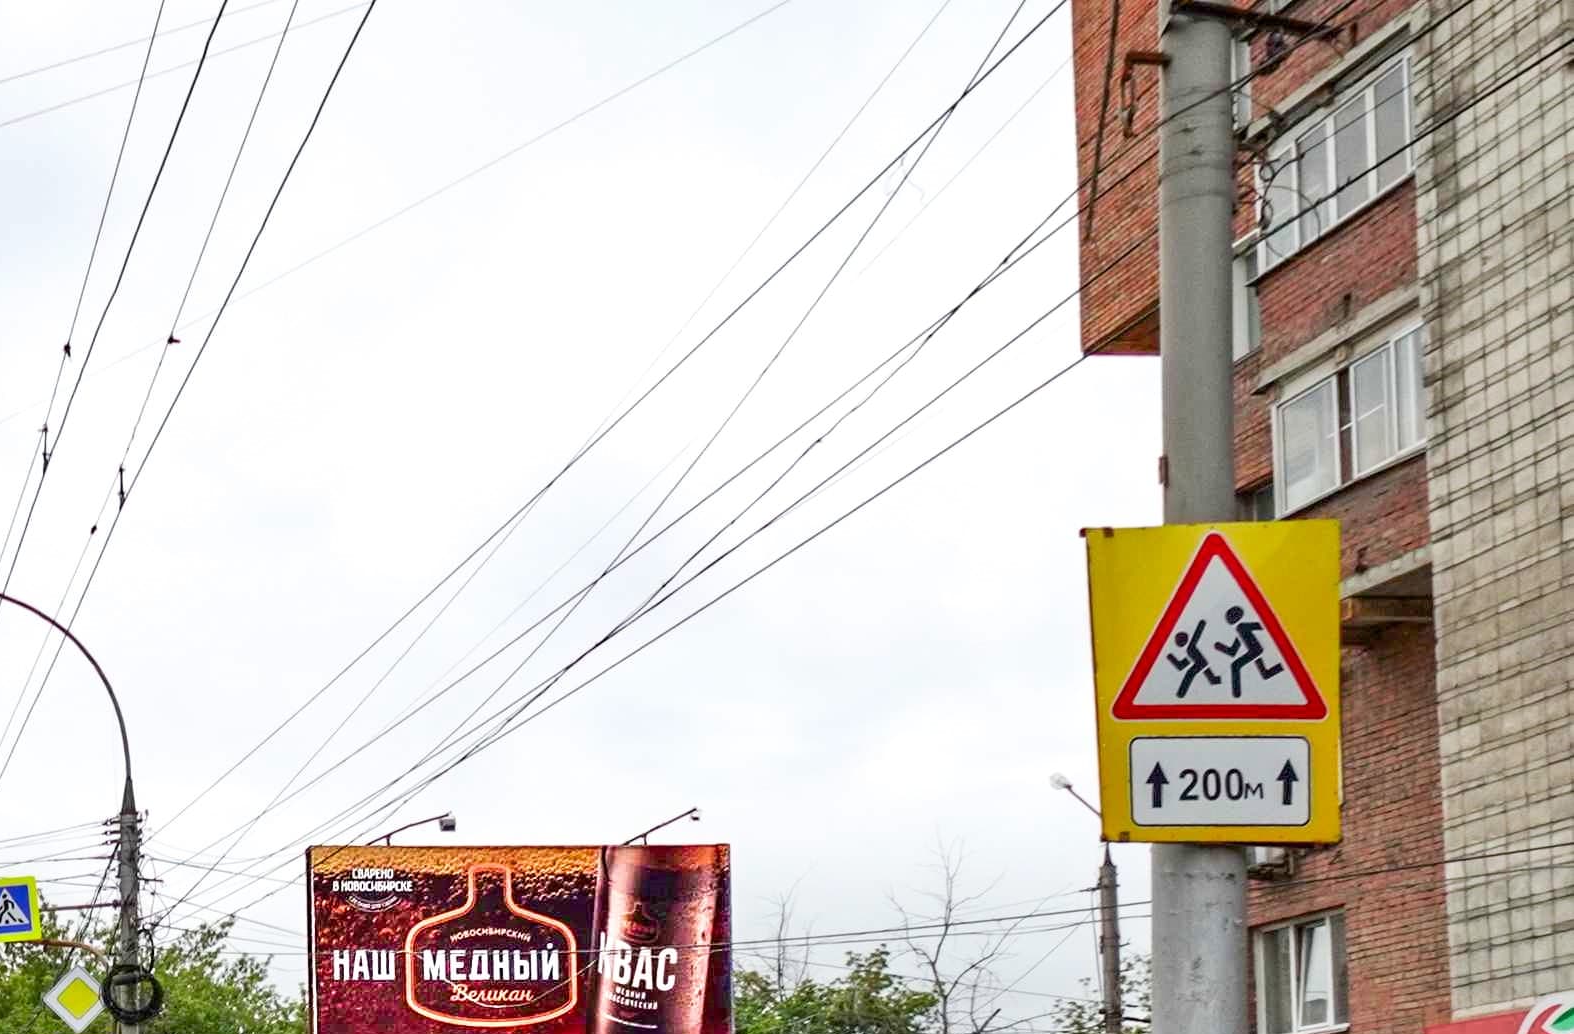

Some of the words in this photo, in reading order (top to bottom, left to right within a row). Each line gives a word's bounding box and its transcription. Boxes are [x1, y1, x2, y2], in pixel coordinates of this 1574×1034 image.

[352, 868, 394, 879] СВАРЕНО
[332, 881, 339, 892] В
[341, 881, 413, 892] НОВОСИБИРСКЕ
[450, 927, 531, 942] НОВОСИБИРСКИЙ
[333, 950, 395, 981] НАШ
[423, 942, 559, 981] МЕДНЫЙ
[598, 931, 678, 991] КВАС
[450, 984, 534, 1002] Великан
